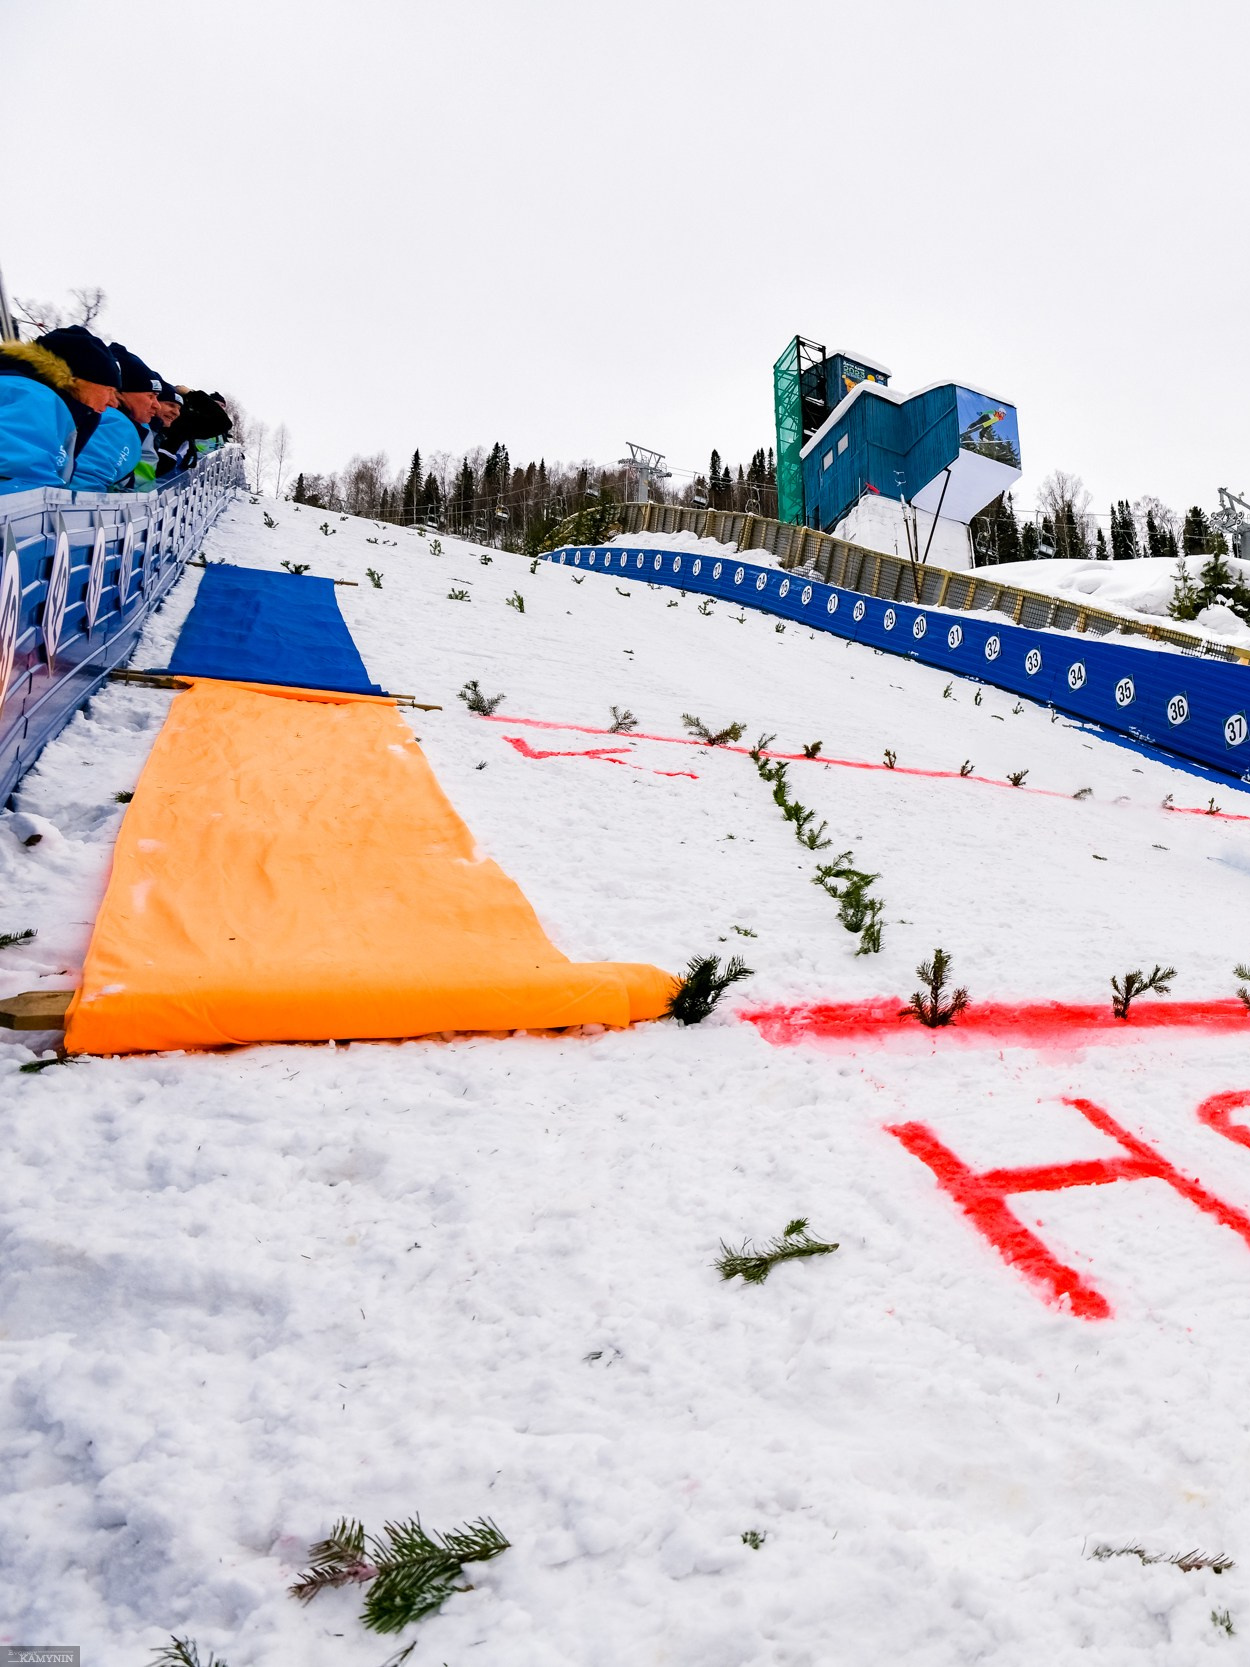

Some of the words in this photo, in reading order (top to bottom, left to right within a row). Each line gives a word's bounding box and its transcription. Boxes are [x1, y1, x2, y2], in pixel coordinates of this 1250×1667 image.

[735, 569, 743, 583] 23
[757, 575, 766, 589] 24
[780, 581, 788, 596] 25
[803, 587, 811, 603] 26
[828, 595, 837, 612] 27
[855, 602, 864, 619] 28
[885, 611, 894, 629] 29
[914, 616, 925, 635] 30
[949, 627, 960, 646] 31
[987, 638, 998, 658] 32
[1027, 648, 1039, 671] 33
[1070, 665, 1084, 687] 34
[1117, 680, 1131, 703] 35
[1169, 698, 1185, 721] 36
[1227, 717, 1245, 742] 37
